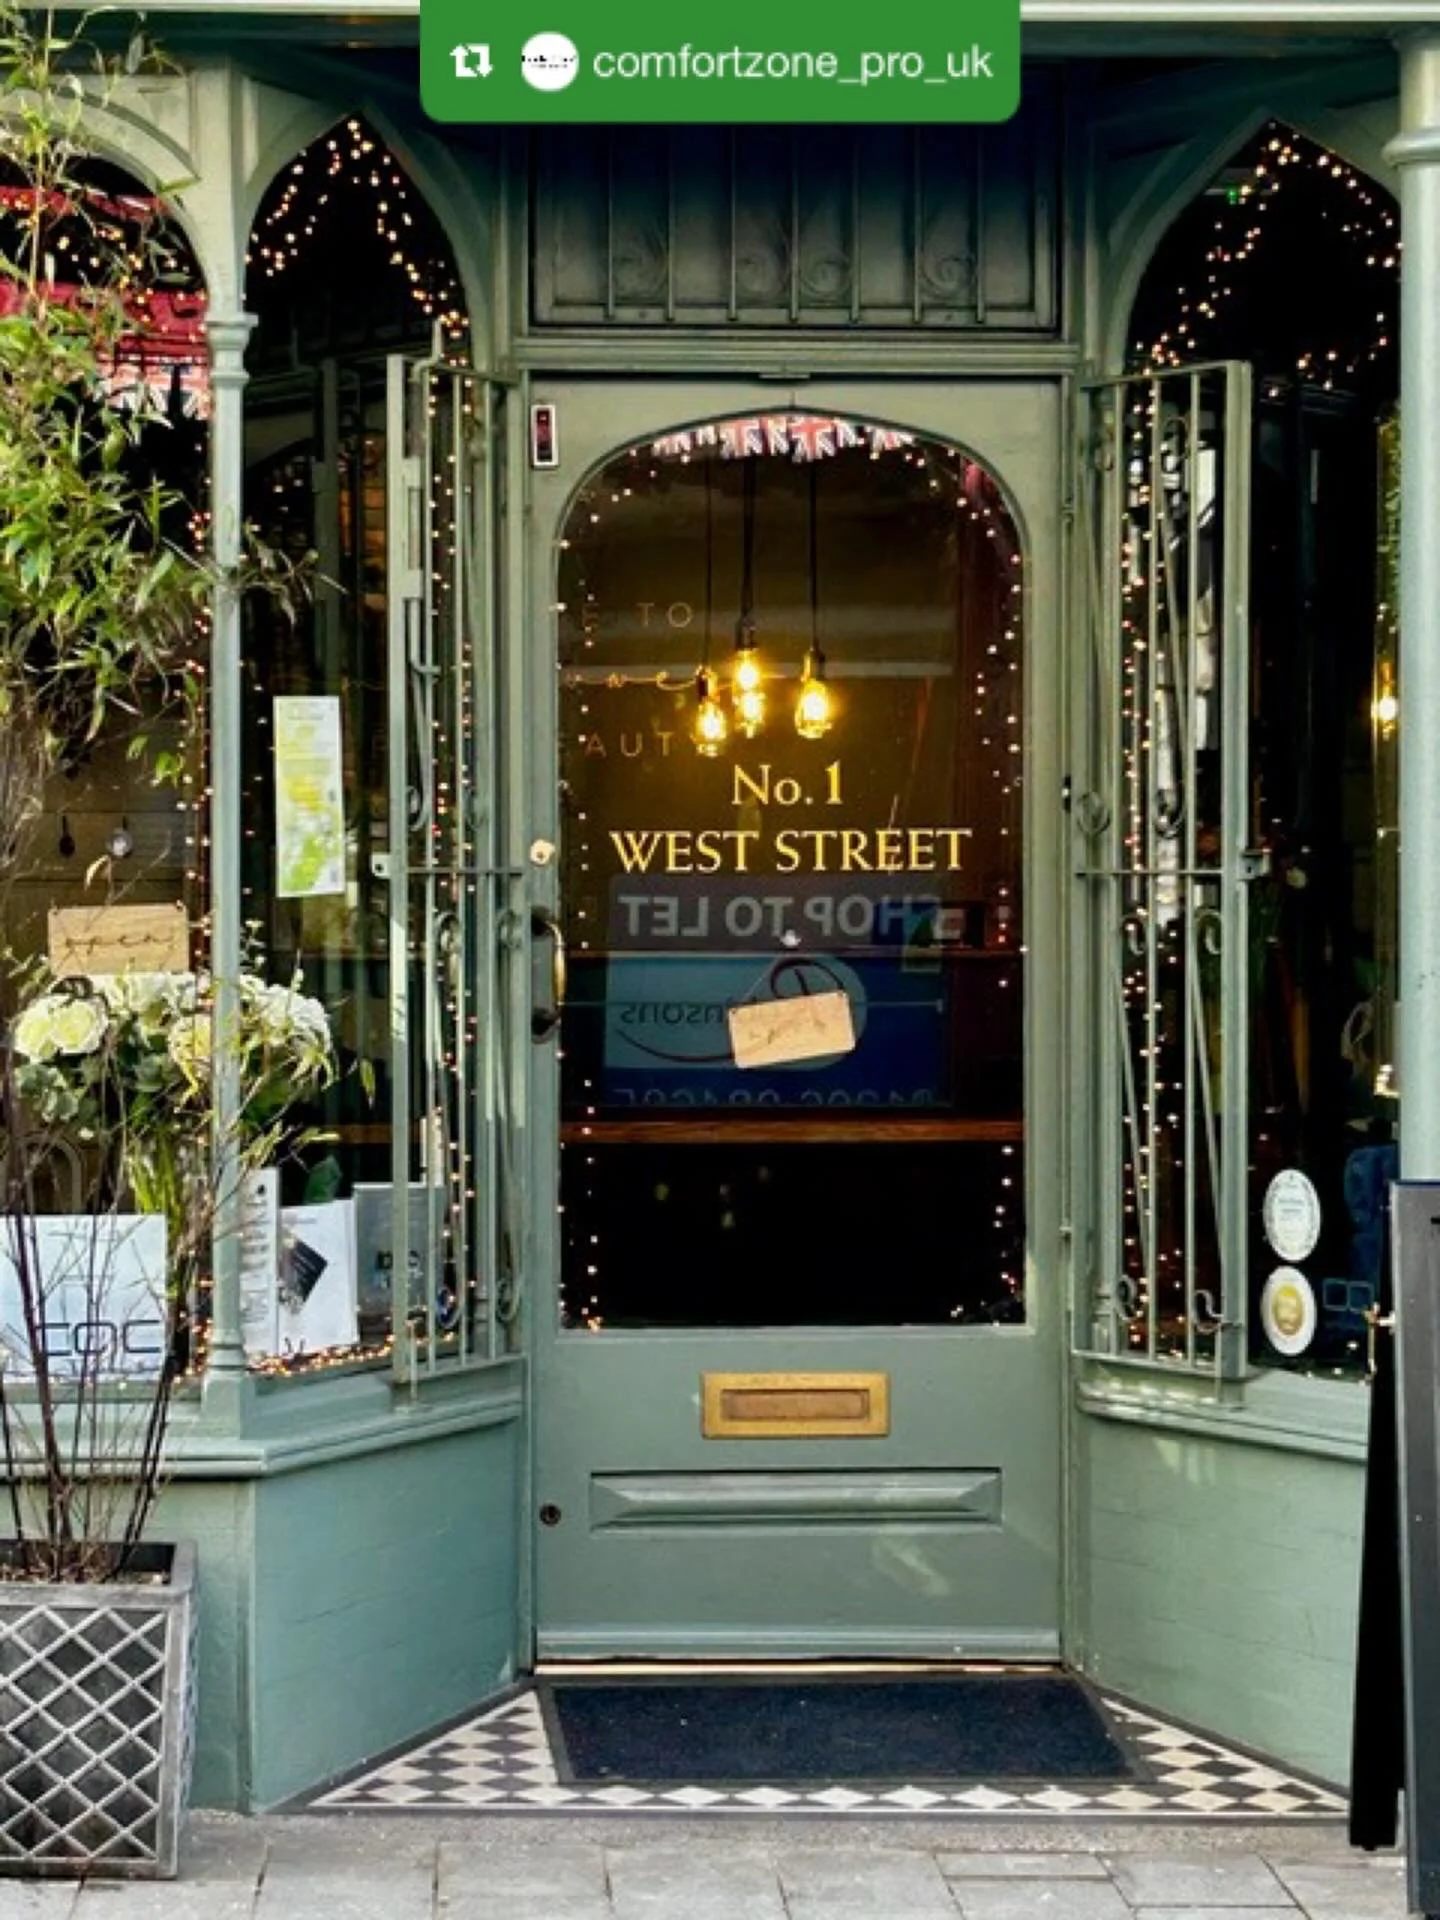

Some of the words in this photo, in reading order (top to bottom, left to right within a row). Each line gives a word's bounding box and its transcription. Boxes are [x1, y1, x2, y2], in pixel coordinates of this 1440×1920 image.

[637, 602, 694, 629] TO
[609, 829, 760, 873] WEST
[776, 828, 973, 872] STREET
